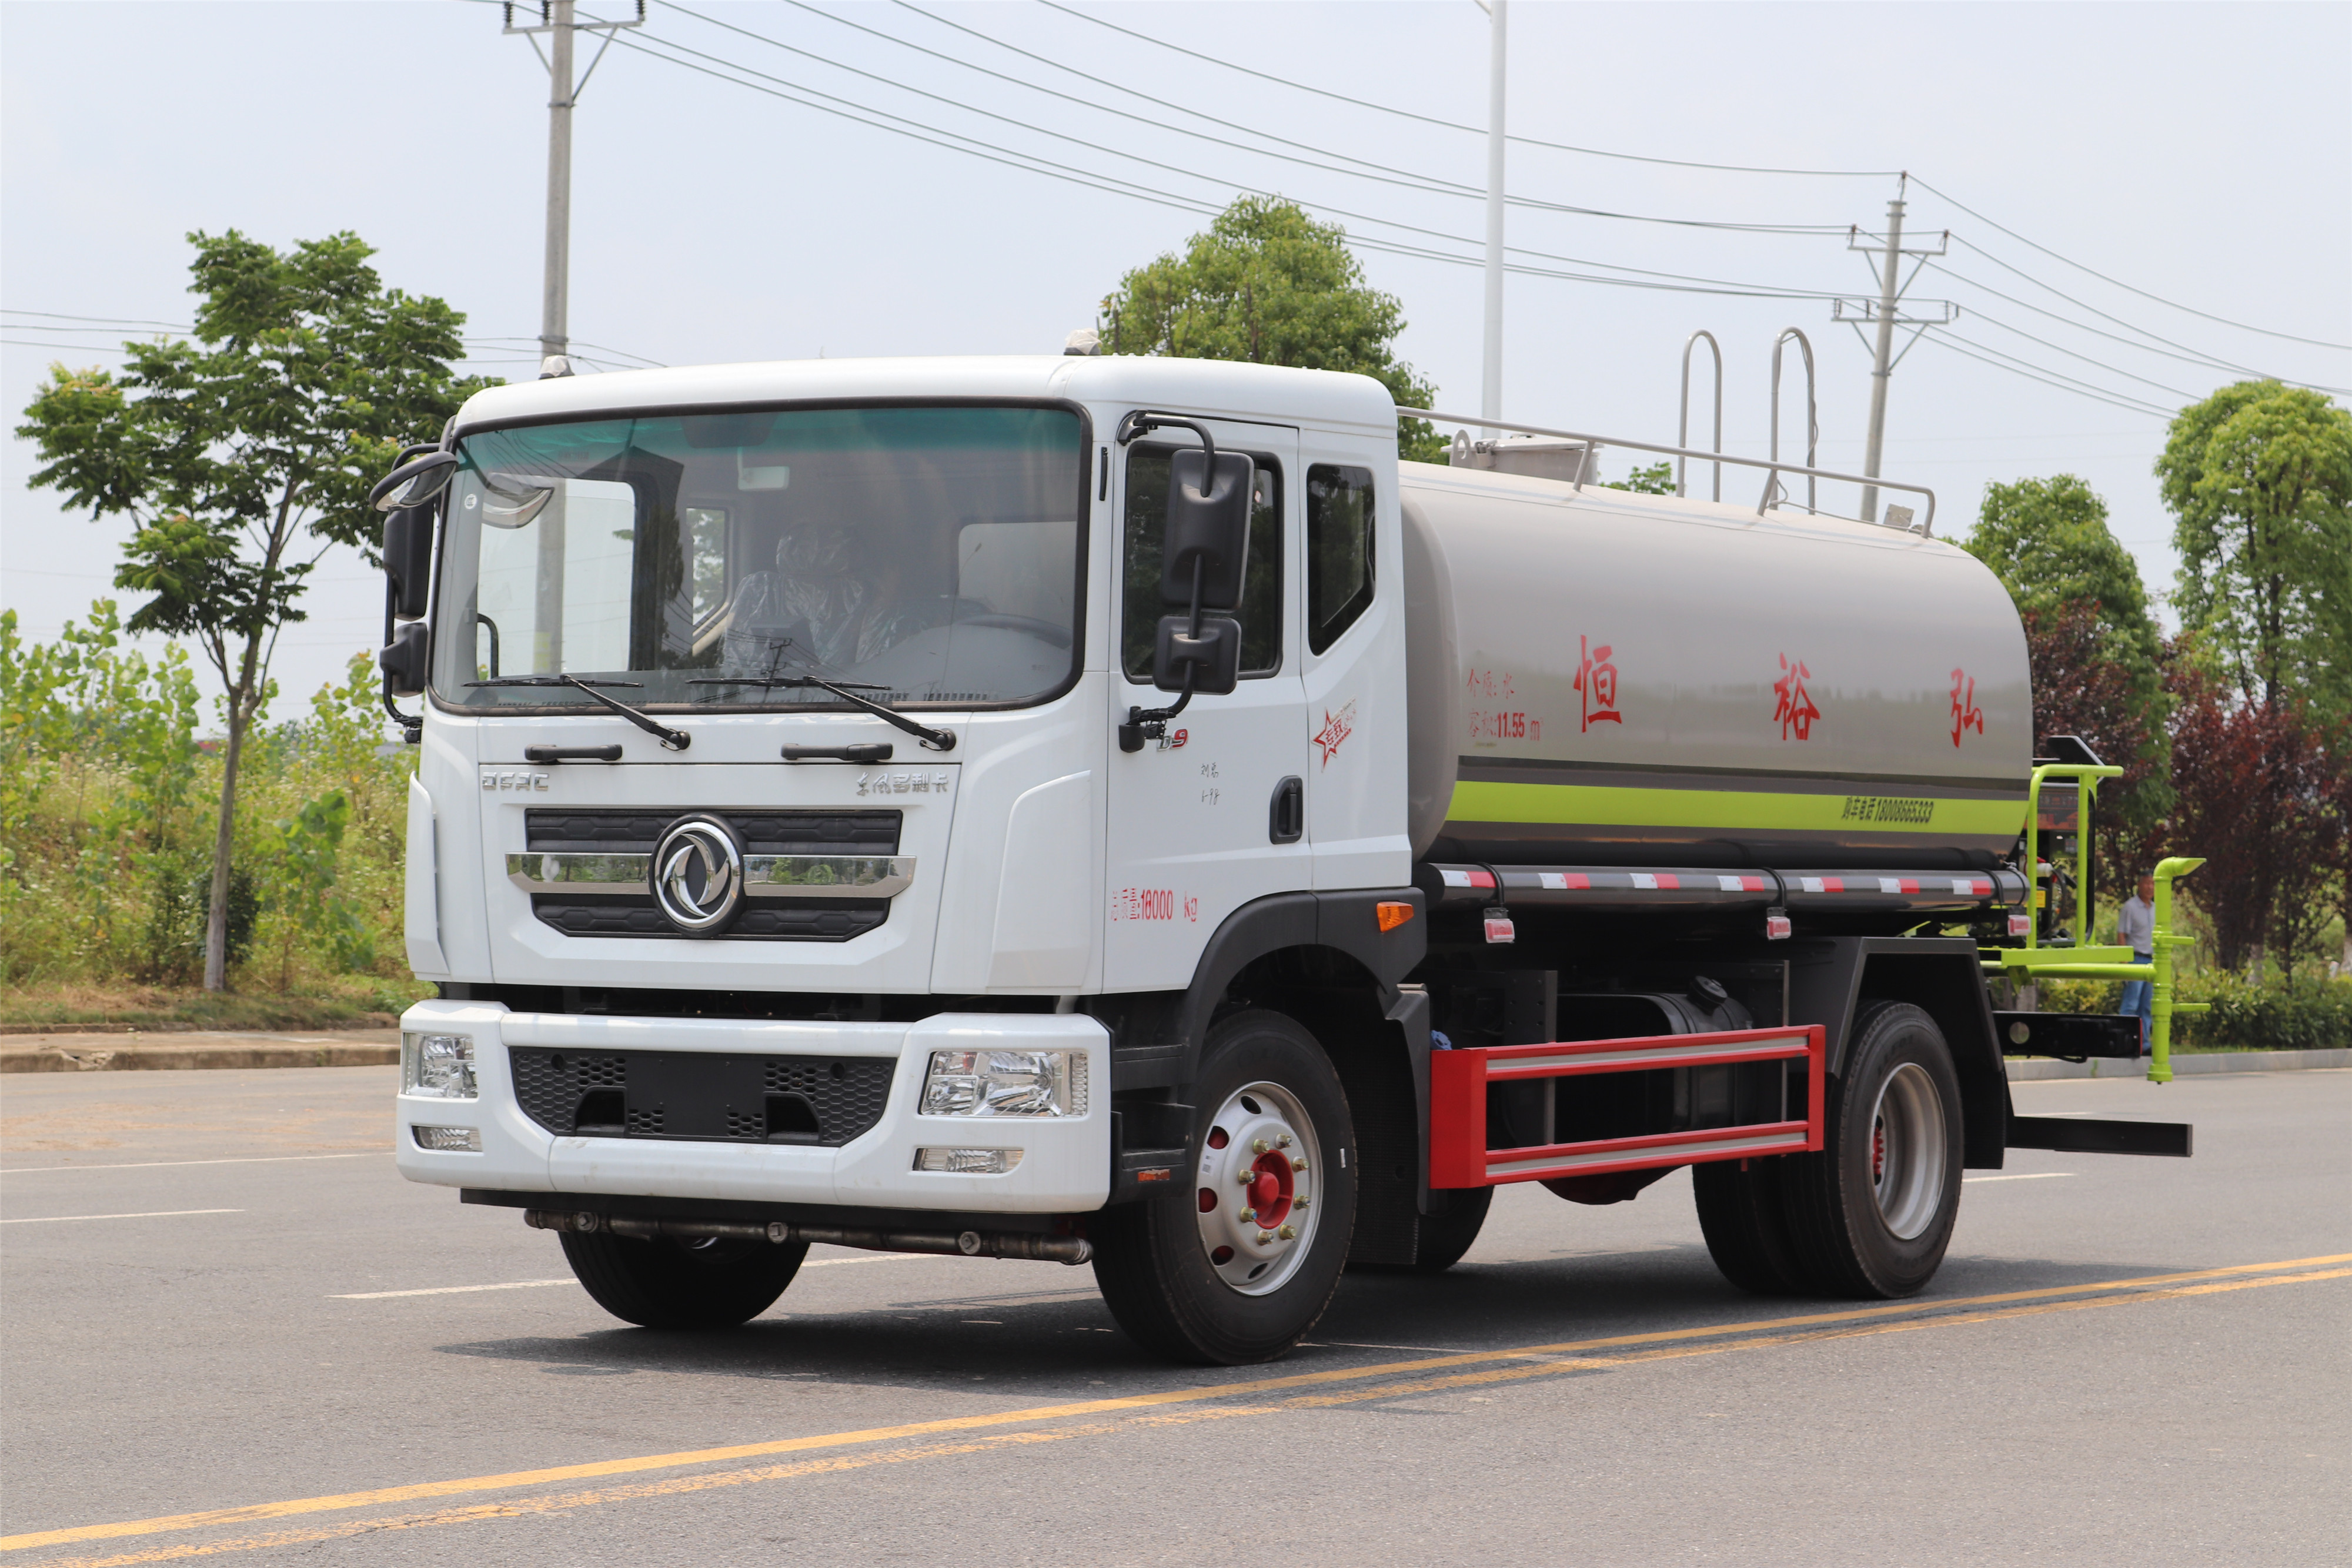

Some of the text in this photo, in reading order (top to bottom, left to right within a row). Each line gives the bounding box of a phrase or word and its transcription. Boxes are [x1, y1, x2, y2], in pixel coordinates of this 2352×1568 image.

[1157, 728, 1189, 752] D9
[482, 772, 549, 791] DFAC
[856, 771, 949, 797] 东风多利卡
[1184, 891, 1198, 922] kg
